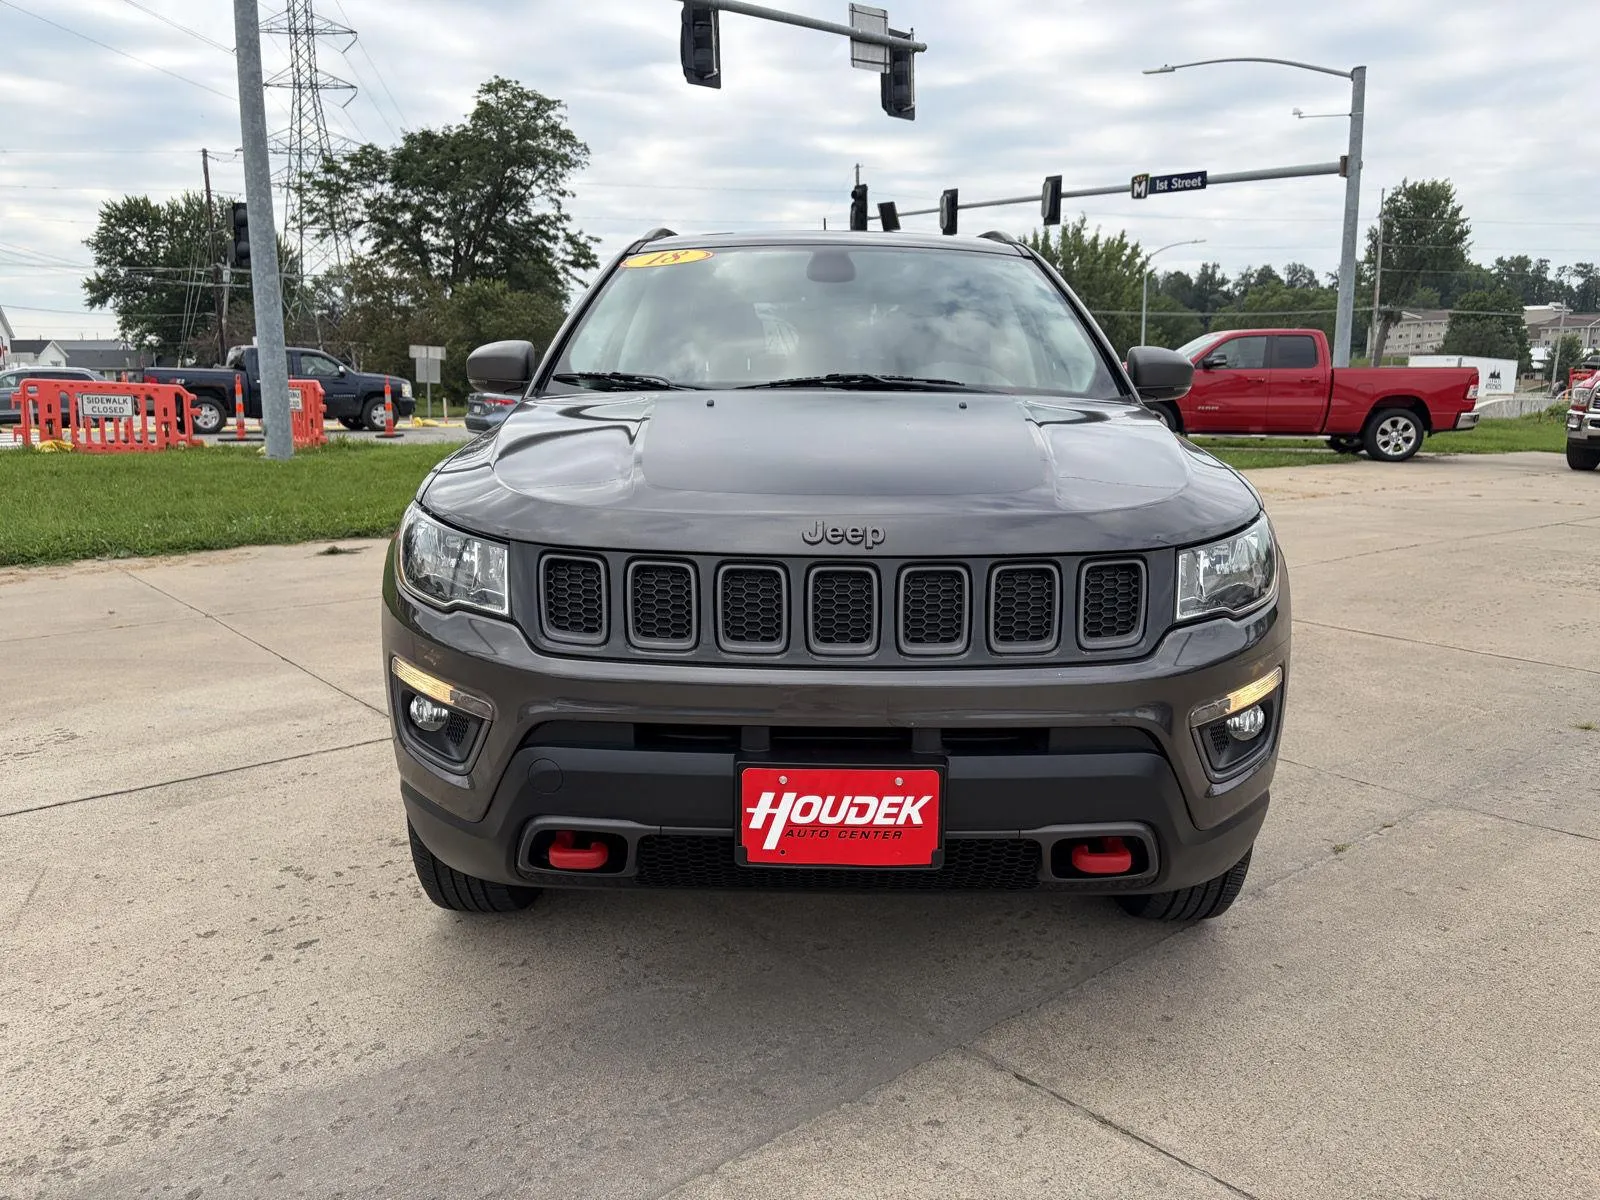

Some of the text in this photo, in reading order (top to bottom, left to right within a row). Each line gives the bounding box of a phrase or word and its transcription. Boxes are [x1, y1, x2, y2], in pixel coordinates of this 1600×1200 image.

[1133, 180, 1146, 197] M
[1156, 176, 1202, 190] 1st Street
[644, 250, 690, 265] 18
[86, 396, 128, 404] SIDEWALK
[802, 520, 886, 550] Jeep
[746, 792, 933, 850] HOUDEK
[784, 829, 903, 840] AUTO CENTER
